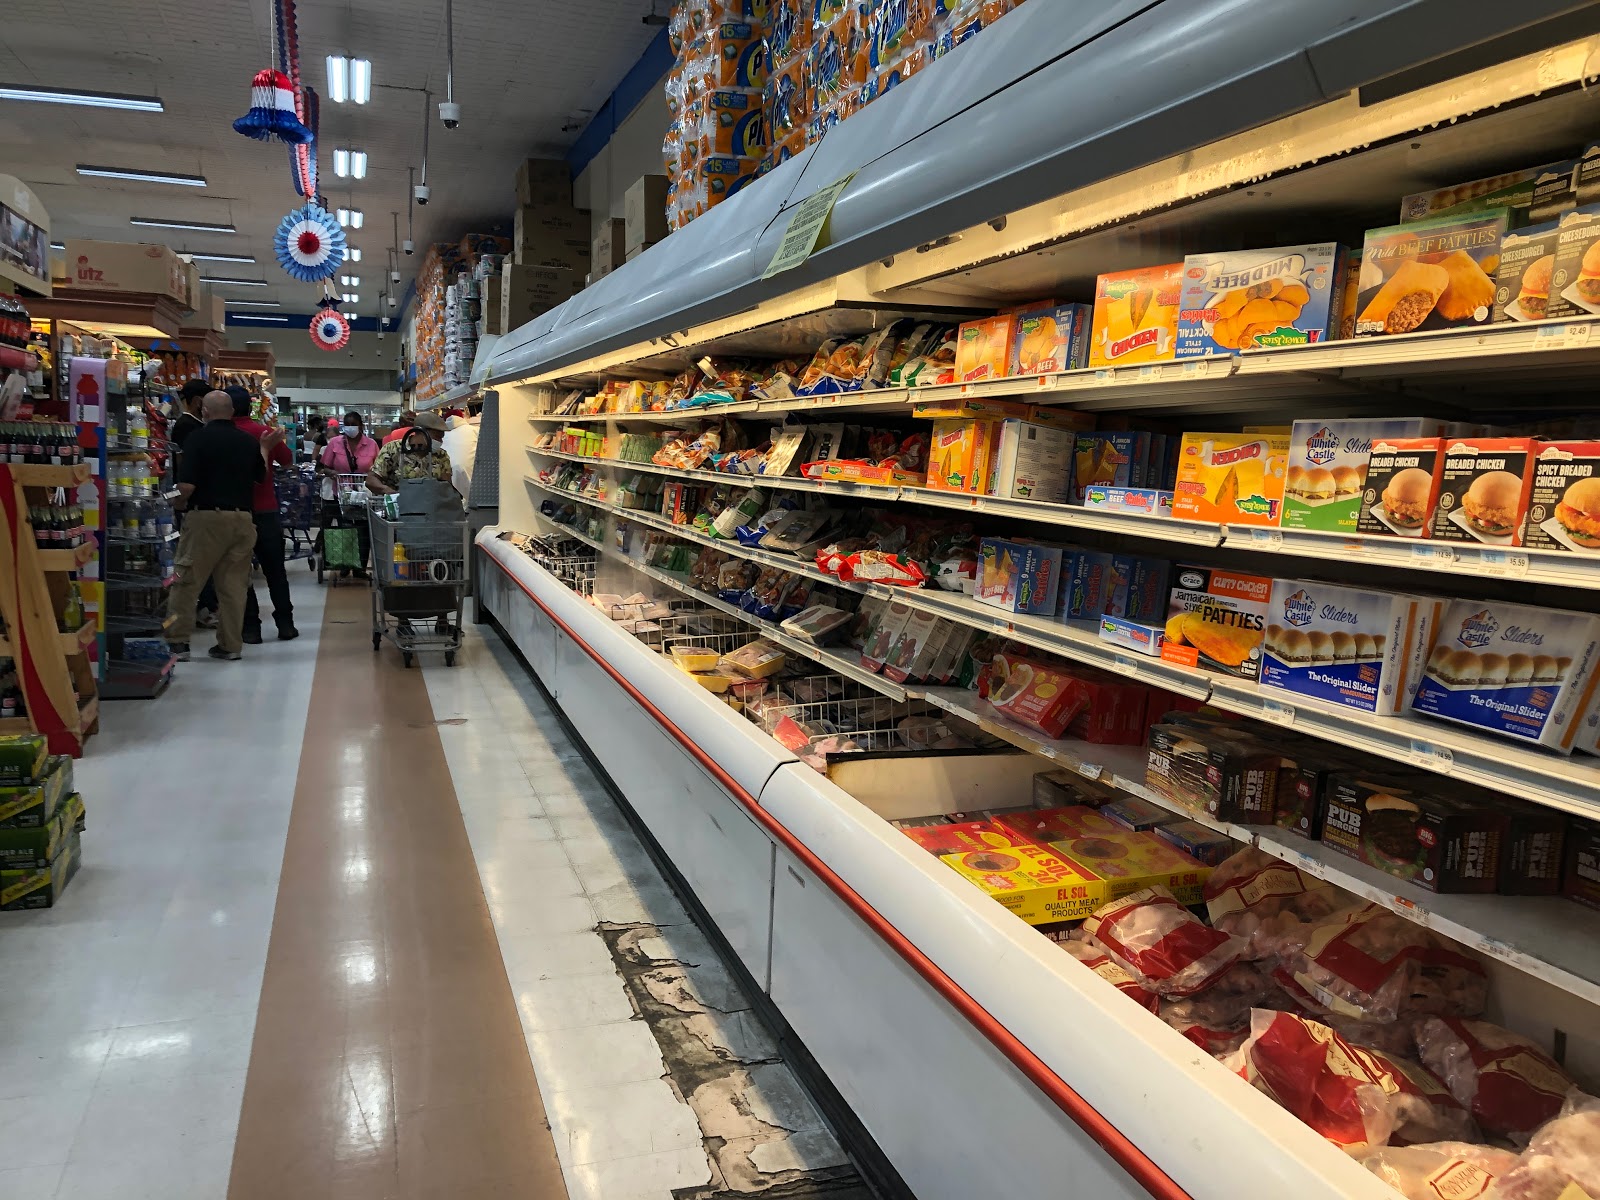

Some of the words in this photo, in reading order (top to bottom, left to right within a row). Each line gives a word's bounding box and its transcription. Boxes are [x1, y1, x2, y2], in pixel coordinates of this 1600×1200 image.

[720, 25, 735, 38] 15
[717, 94, 731, 106] 15
[709, 160, 723, 172] 15
[1366, 245, 1397, 260] Mild
[1398, 237, 1436, 256] BEEF
[1438, 229, 1497, 250] PATTIES
[1501, 244, 1545, 263] CHEESEBURGER
[1252, 257, 1293, 281] MILD
[1211, 270, 1250, 289] BEEF
[1181, 308, 1221, 324] Patties
[1179, 326, 1214, 339] COCKTAIL
[1111, 329, 1159, 357] CHICKEN
[1176, 347, 1205, 355] JAMAICAN
[1037, 361, 1054, 374] BEEF
[1311, 437, 1336, 450] White
[1211, 442, 1261, 466] CHICKEN
[1307, 449, 1336, 461] Castle
[1370, 457, 1394, 467] BREADED
[1394, 457, 1420, 467] CHICKEN
[1445, 459, 1475, 470] BREADED
[1475, 459, 1506, 470] CHICKEN
[1537, 465, 1557, 476] SPICY
[1557, 465, 1593, 476] BREADED
[1535, 476, 1566, 488] CHICKEN
[1109, 494, 1124, 503] BEEF
[1125, 492, 1148, 507] Patties
[1285, 509, 1291, 519] 6
[1509, 557, 1526, 567] $5.59
[1033, 559, 1051, 607] Patties
[1183, 575, 1201, 585] Grace
[1175, 591, 1216, 605] Jamaican
[1288, 598, 1313, 612] White
[1202, 606, 1264, 632] PATTIES
[1284, 609, 1312, 623] Castle
[1320, 604, 1359, 625] Sliders
[1467, 620, 1494, 633] White
[1459, 629, 1490, 645] Castle
[1501, 625, 1545, 646] Sliders
[1264, 665, 1270, 676] 6
[1308, 671, 1322, 682] The
[1322, 674, 1352, 689] Original
[1352, 681, 1378, 694] Slider
[1470, 694, 1485, 706] The
[1485, 698, 1519, 714] Original
[1518, 706, 1546, 720] Slider
[1149, 751, 1170, 770] PUB
[1147, 762, 1170, 778] BURGER
[1244, 769, 1258, 811] PUB
[1253, 770, 1265, 812] BURGER
[1328, 804, 1362, 828] PUB
[1327, 816, 1360, 836] BURGER
[1020, 848, 1036, 859] EL
[1037, 858, 1074, 880] SOL
[1028, 870, 1059, 884] 30
[1170, 875, 1181, 887] EL
[1183, 873, 1199, 885] SOL
[1057, 888, 1068, 901] EL
[1071, 886, 1088, 899] SOL
[1045, 900, 1078, 911] QUALITY
[1079, 898, 1100, 908] MEAT
[1051, 906, 1094, 919] PRODUCTS
